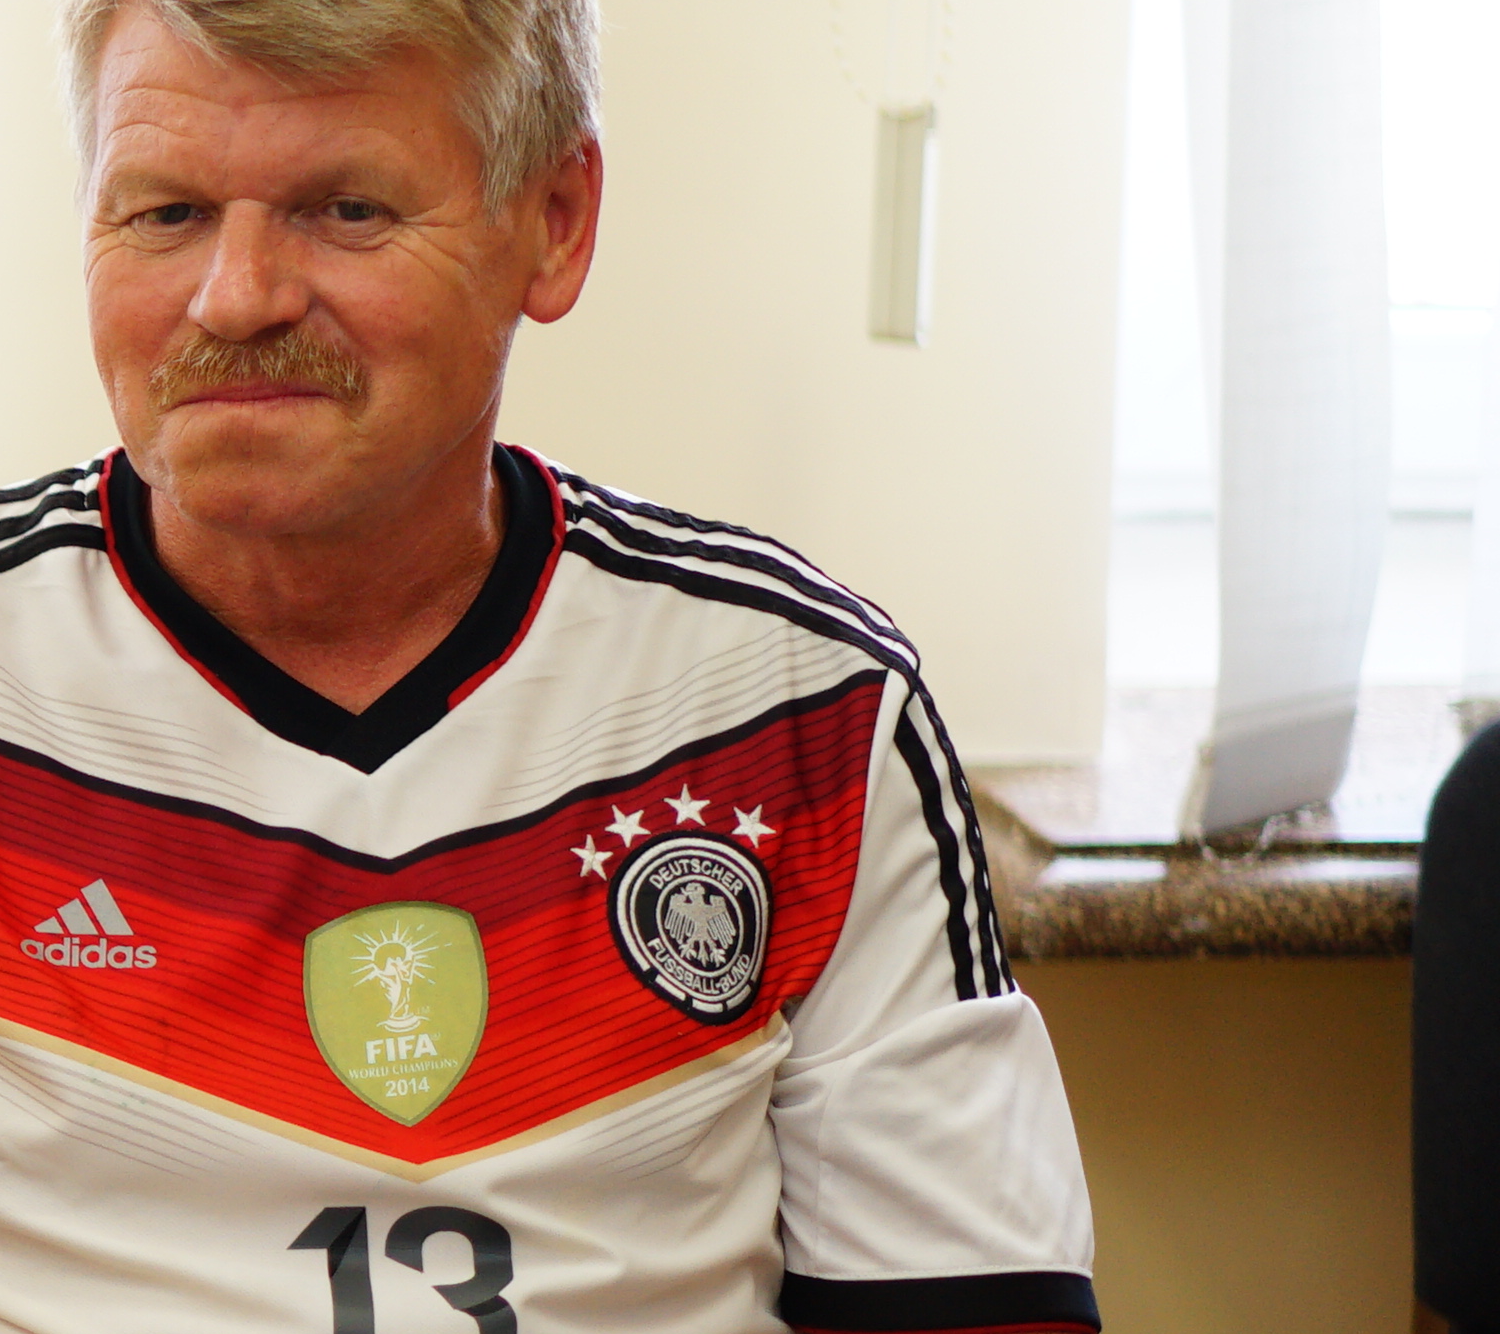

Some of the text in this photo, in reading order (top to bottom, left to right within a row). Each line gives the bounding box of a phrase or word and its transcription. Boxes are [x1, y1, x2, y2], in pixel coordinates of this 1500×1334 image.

[649, 858, 745, 897] DEUTSCHER
[20, 937, 158, 969] adidas
[646, 937, 752, 996] FUSSBALL-BUND
[365, 1033, 439, 1064] FIFA
[348, 1058, 459, 1080] WORLD CHAMPIONS
[385, 1076, 431, 1098] 2014
